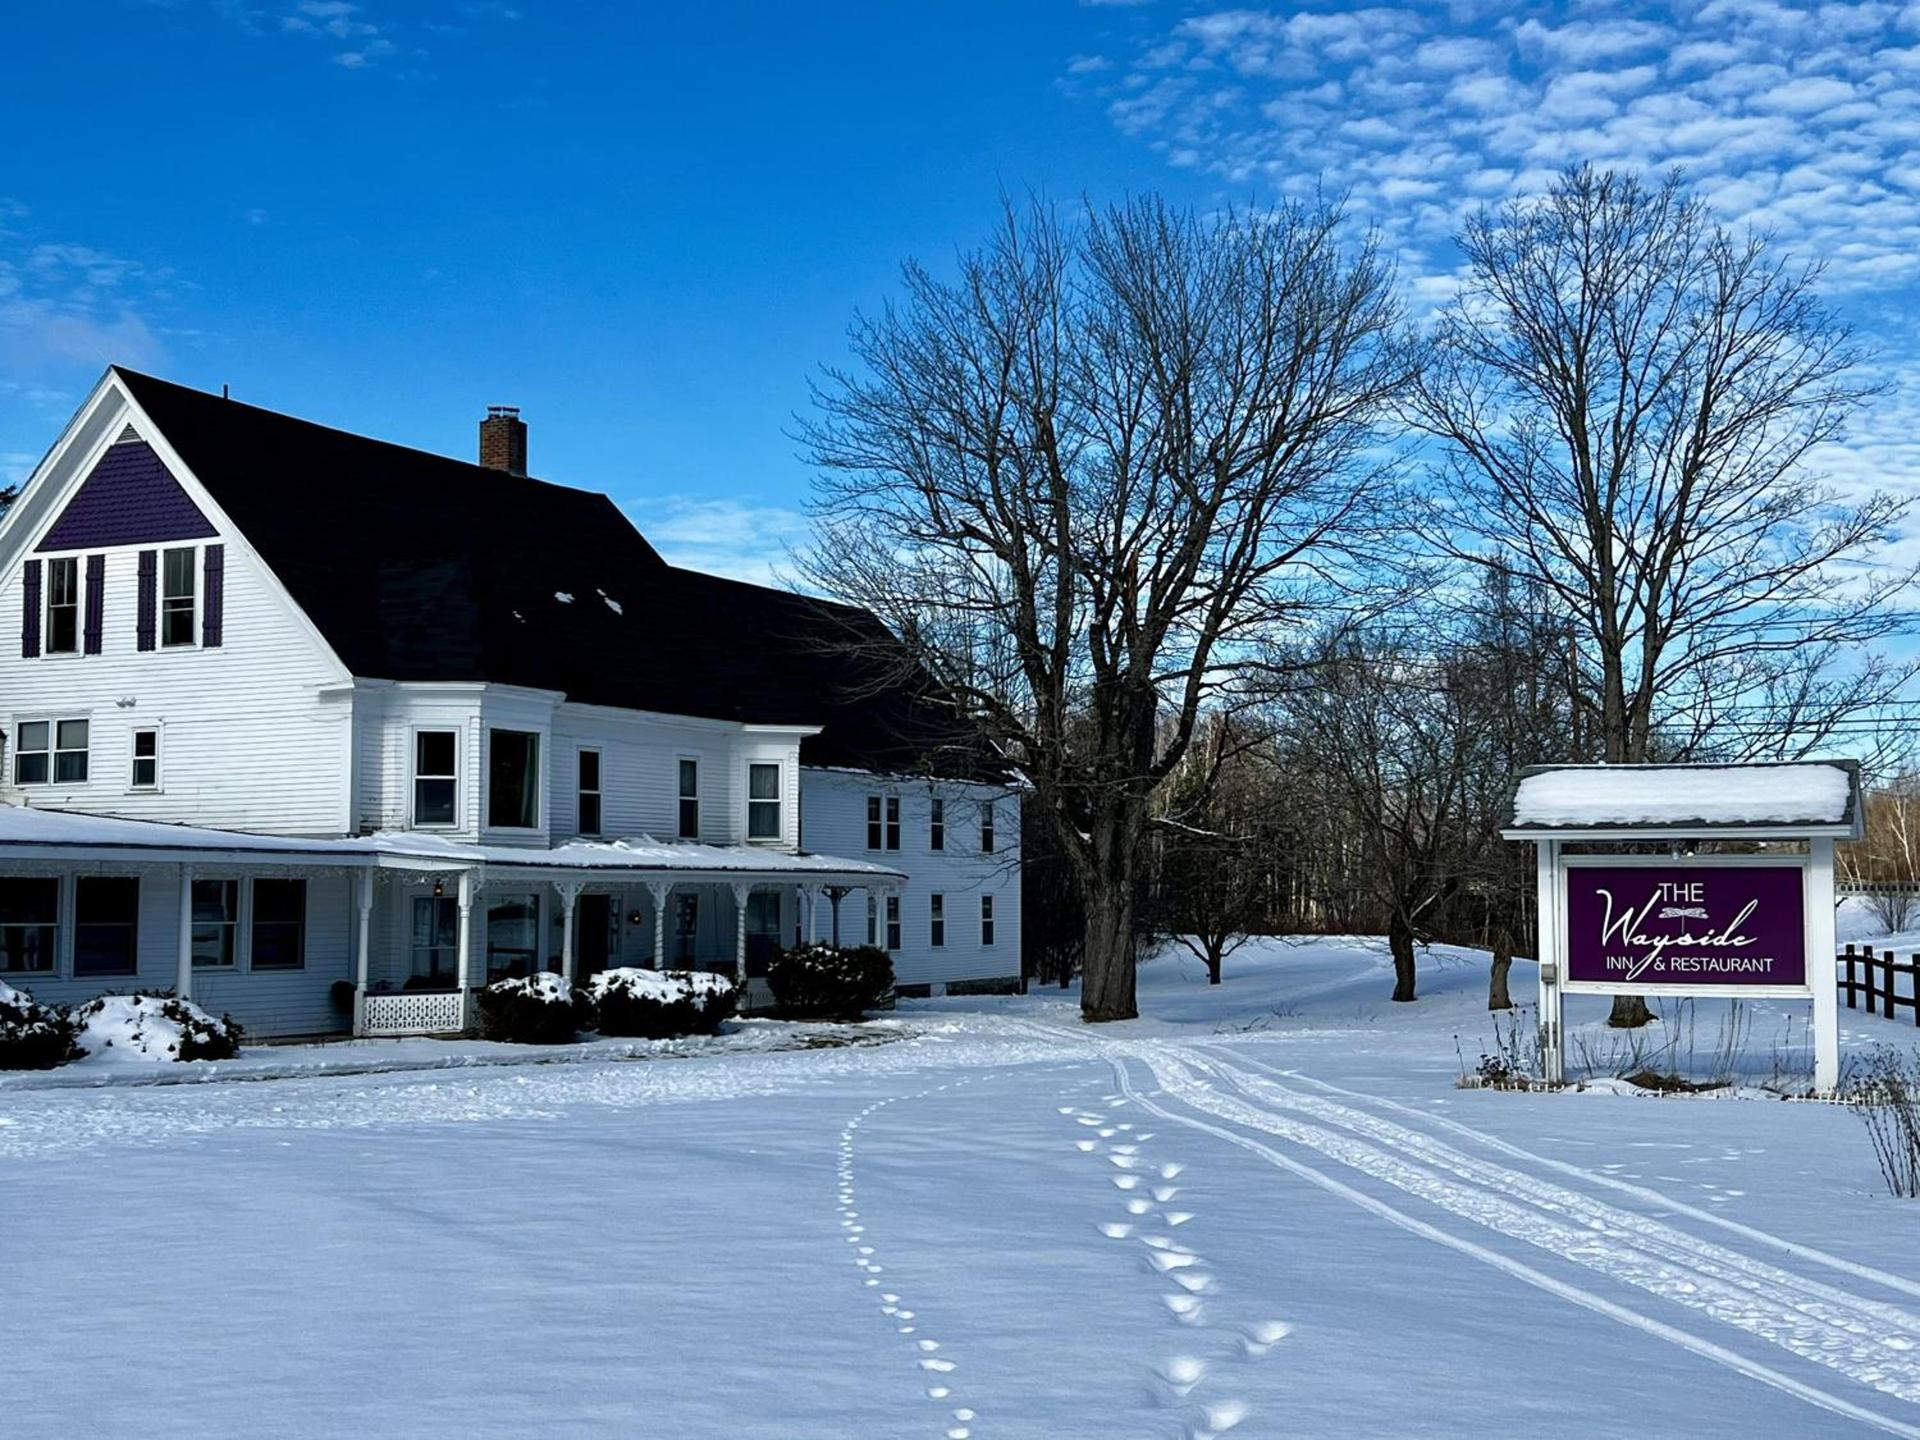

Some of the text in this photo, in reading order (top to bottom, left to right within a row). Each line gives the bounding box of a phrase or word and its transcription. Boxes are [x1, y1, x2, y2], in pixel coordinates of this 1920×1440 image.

[1658, 883, 1704, 902] THE
[1596, 889, 1758, 981] Wayside
[1606, 956, 1774, 972] INN & RESTAURANT
